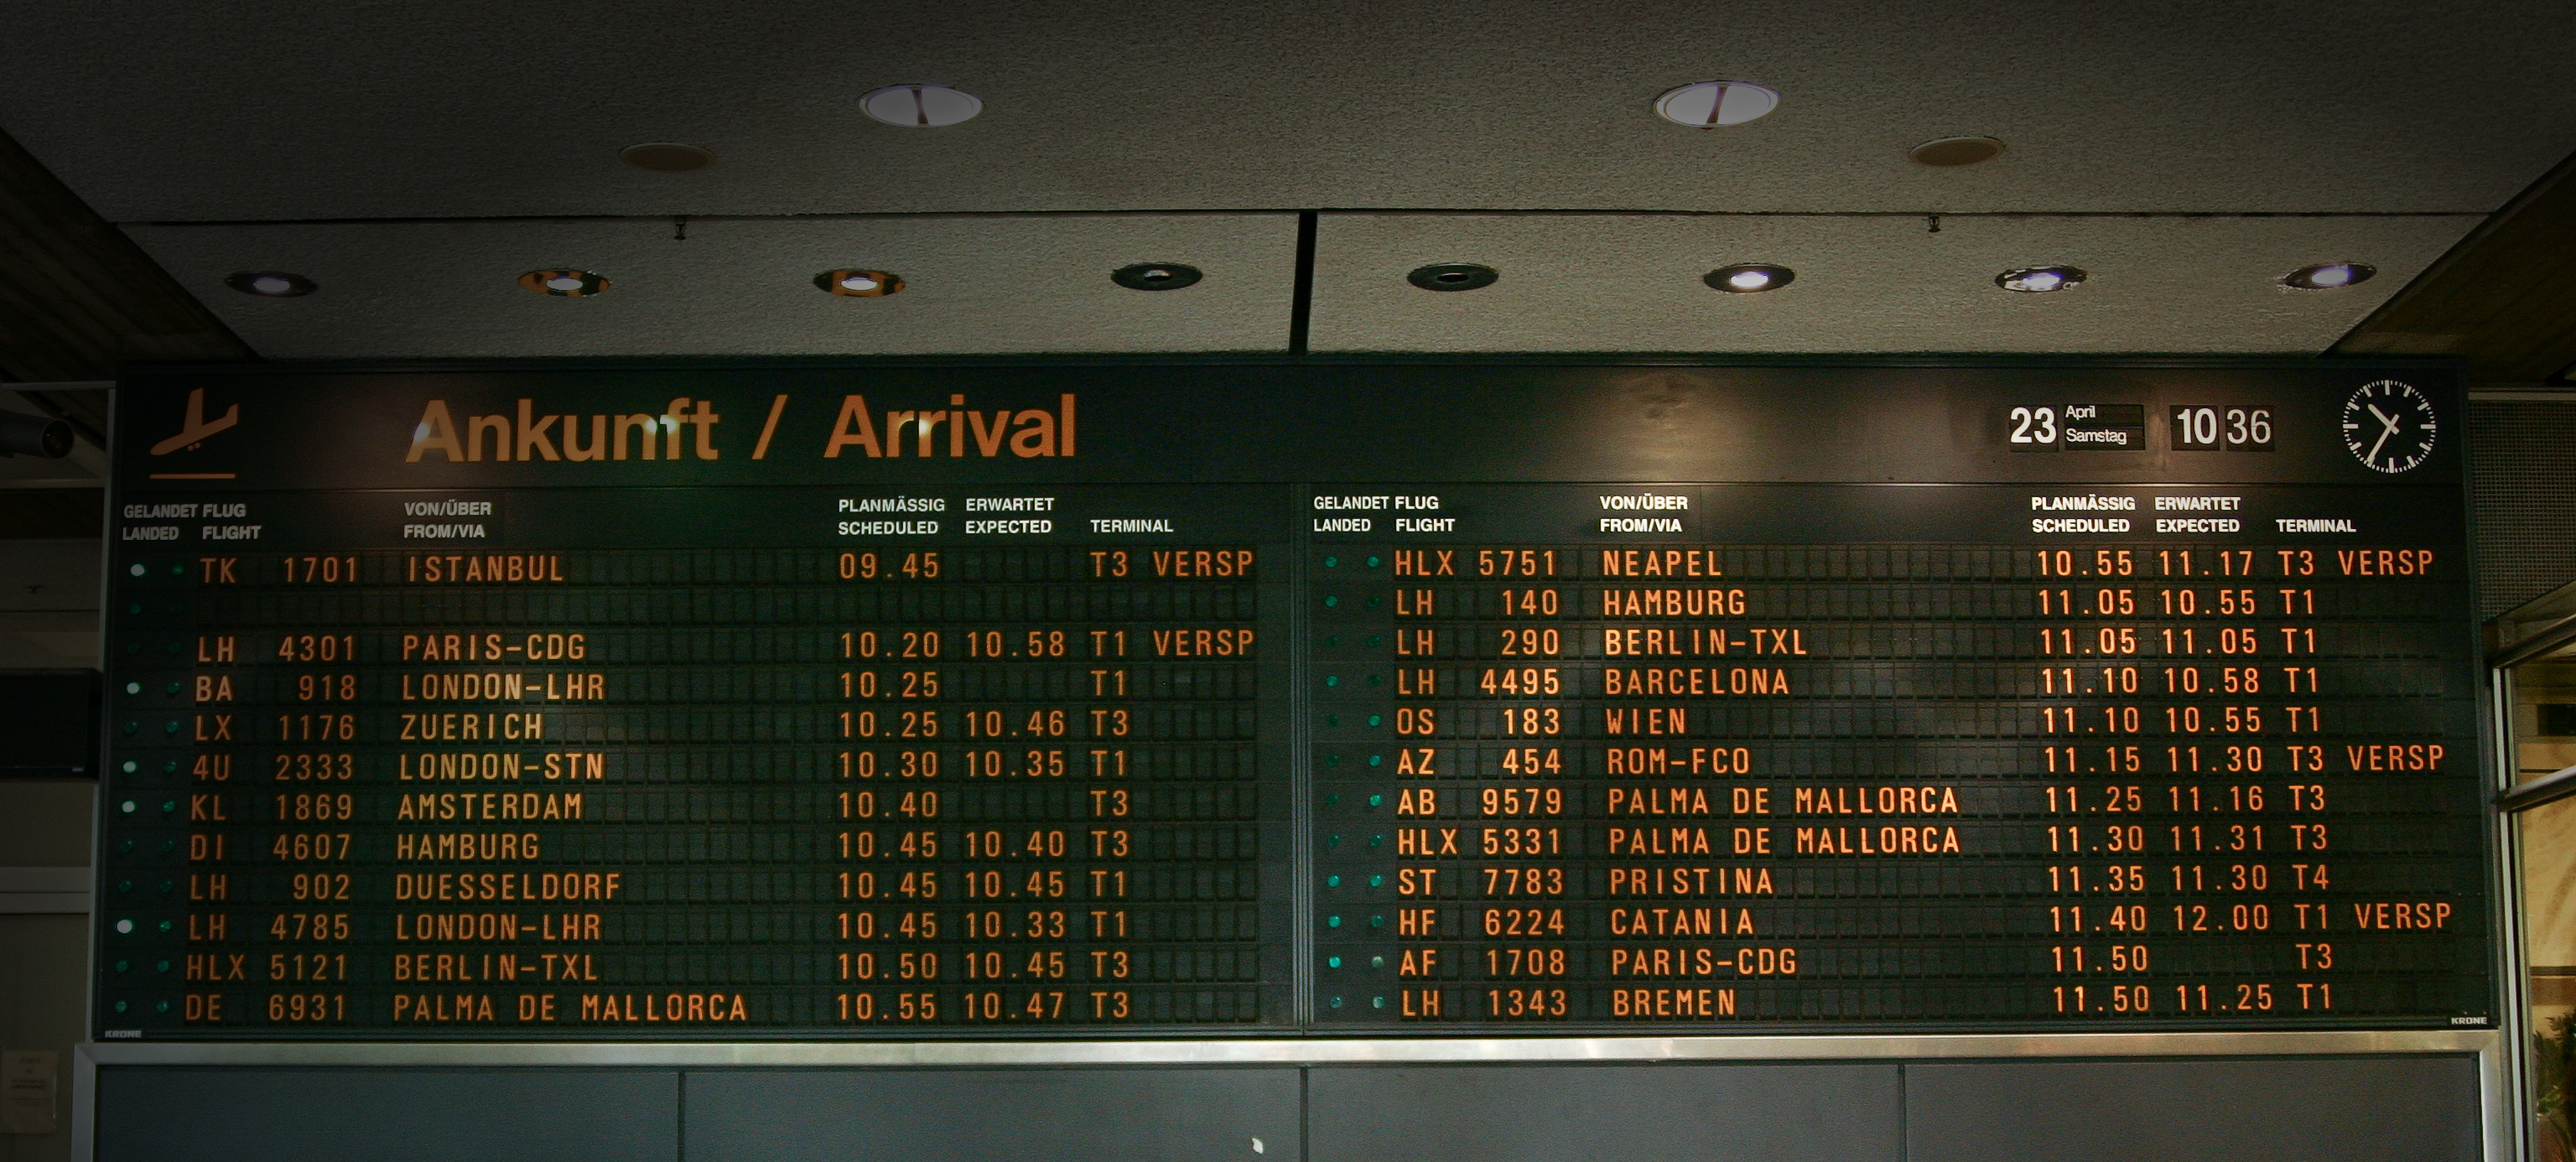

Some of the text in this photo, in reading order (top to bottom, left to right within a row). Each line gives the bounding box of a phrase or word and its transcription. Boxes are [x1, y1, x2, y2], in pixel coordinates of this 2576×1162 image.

[404, 393, 1076, 464] Ankunft / Arrival
[2011, 406, 2096, 443] 23 April
[2066, 428, 2127, 444] Samstag
[2178, 408, 2270, 444] 10 36
[124, 495, 1054, 518] GELANDET FLUG VON/ÜBER PLANMÄSSIG ERWARTET
[1314, 493, 2241, 510] GELANDET FLUG VON/ÜBER PLANMÄSSIG ERWARTET
[122, 520, 1173, 540] LANDED FLIGHT FROM/VIA SCHEDULED EXPECTED TERMINAL
[1314, 518, 2356, 532] LANDED FLIGHT FROM/VIA SCHEDULED EXPECTED TERMINAL
[200, 550, 1254, 583] TK 1701 ISTANBUL 09.45 T3 VERSP
[1395, 549, 2433, 576] HLX 5751 NEAPEL 10.55 11.17 T3 VERSP
[1397, 589, 2314, 615] LH 140 HAMBURG 11.05 10.55 T1
[197, 629, 1254, 662] LH 4301 PARIS-CDG 10.20 10.58 T1 VERSP
[1397, 627, 2315, 656] LH 290 BERLIN-TXL 11.05 11.05 T1
[1398, 666, 2318, 695] LH 4495 BARCELONA 11.10 10.58 T1
[195, 709, 1129, 741] LX 1176 ZUERICH 10.25 10.46 T3
[193, 750, 1125, 781] 4U 2333 LONDON-STN 10.30 10.35 T1
[1397, 744, 2444, 775] AZ 454 ROM-FCO 11.15 11.30 T3 VERSP
[1397, 785, 2325, 815] AB 9579 PALMA DE MALLORCA 11.25 11.16 T3
[190, 829, 1129, 860] DI 4607 HAMBURG 10.45 10.40 T3
[1398, 824, 2328, 855] HLX 5331 PALMA DE MALLORCA 11.30 11.31 T3
[190, 869, 1125, 900] LH 902 DUESSELDORF 10.45 10.45 T1
[189, 910, 1126, 941] LH 4785 LONDON-LHR 10.45 10.33 T1
[1400, 902, 2452, 936] HF 6224 CATANIA 11.40 12.00 T1 VERSP
[186, 950, 1130, 981] HLX 5121 BERLIN-TXL 10.50 10.45 T3
[185, 991, 1130, 1021] DE 6931 PALMA DE MALLORCA 10.55 10.47 T3
[1402, 983, 2331, 1016] LH 1343 BREMEN 11.50 11.25 T1
